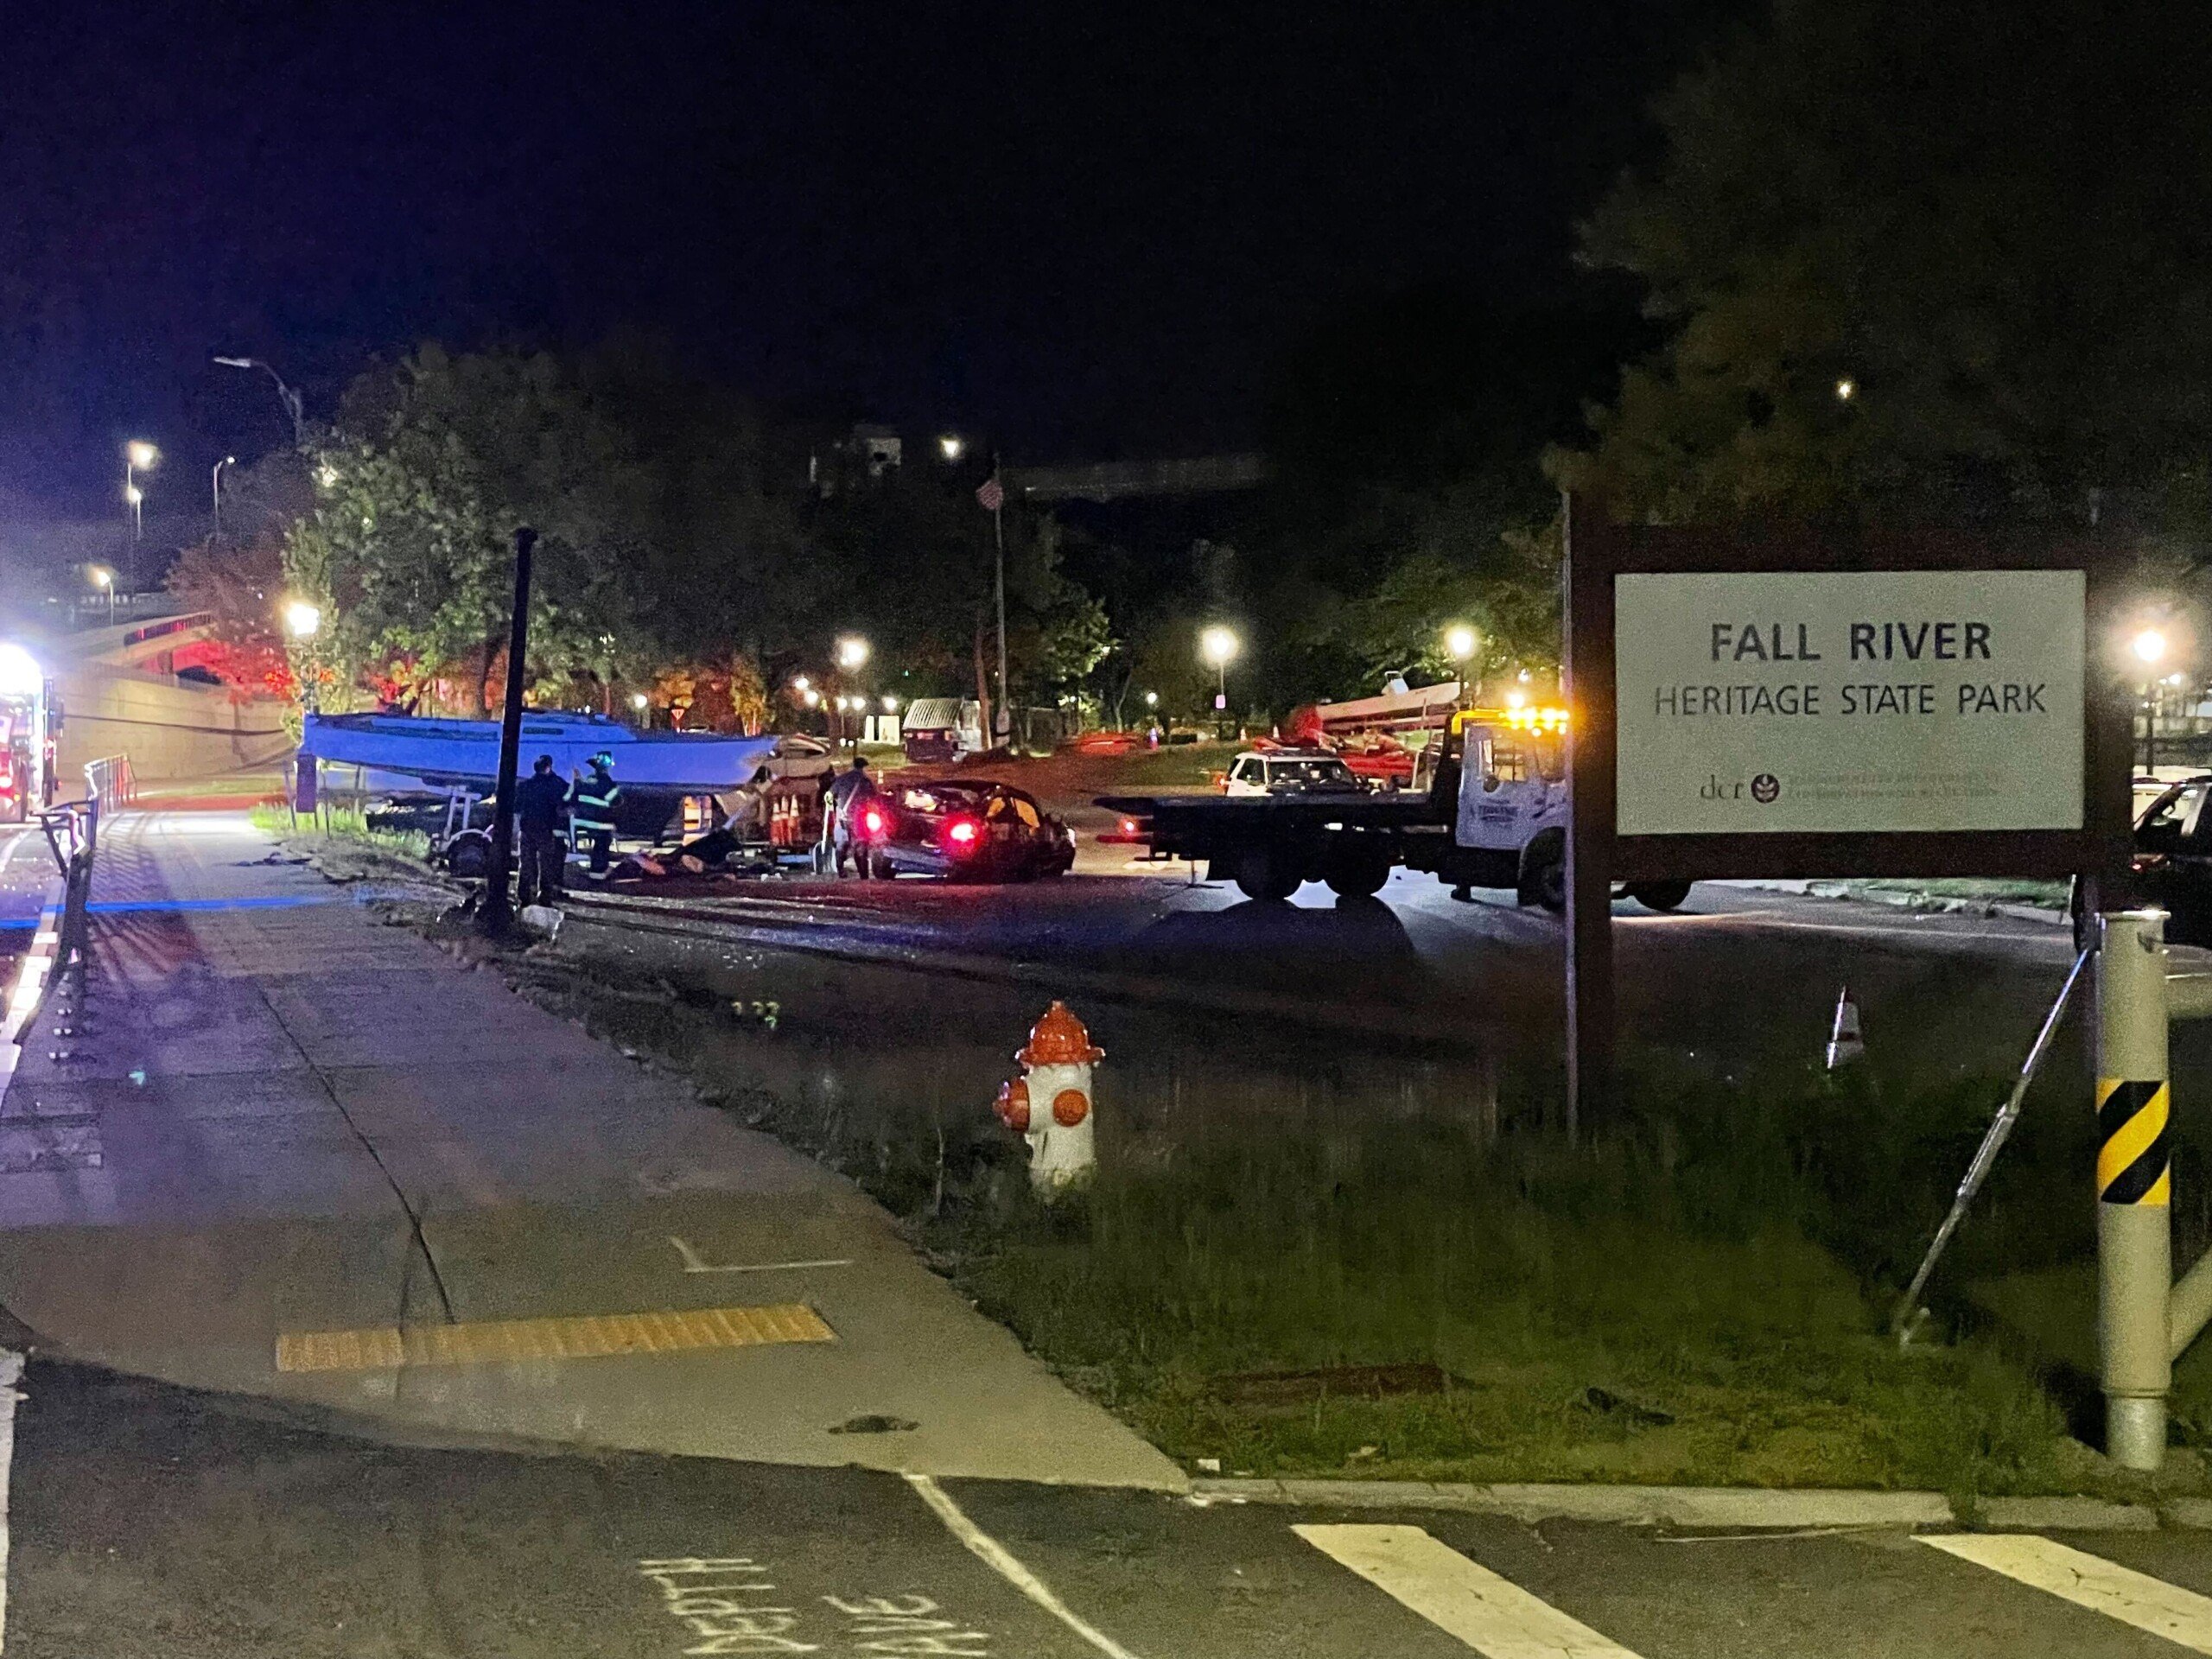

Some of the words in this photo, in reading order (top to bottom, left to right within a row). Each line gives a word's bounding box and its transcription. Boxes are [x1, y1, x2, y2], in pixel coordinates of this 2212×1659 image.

[1711, 622, 1821, 662] FALL
[1849, 621, 1992, 661] RIVER
[1655, 684, 1821, 716] HERITAGE
[1840, 683, 1936, 715] STATE
[1958, 683, 2047, 715] PARK
[1700, 774, 1744, 800] dcr
[821, 1594, 989, 1659] AVE
